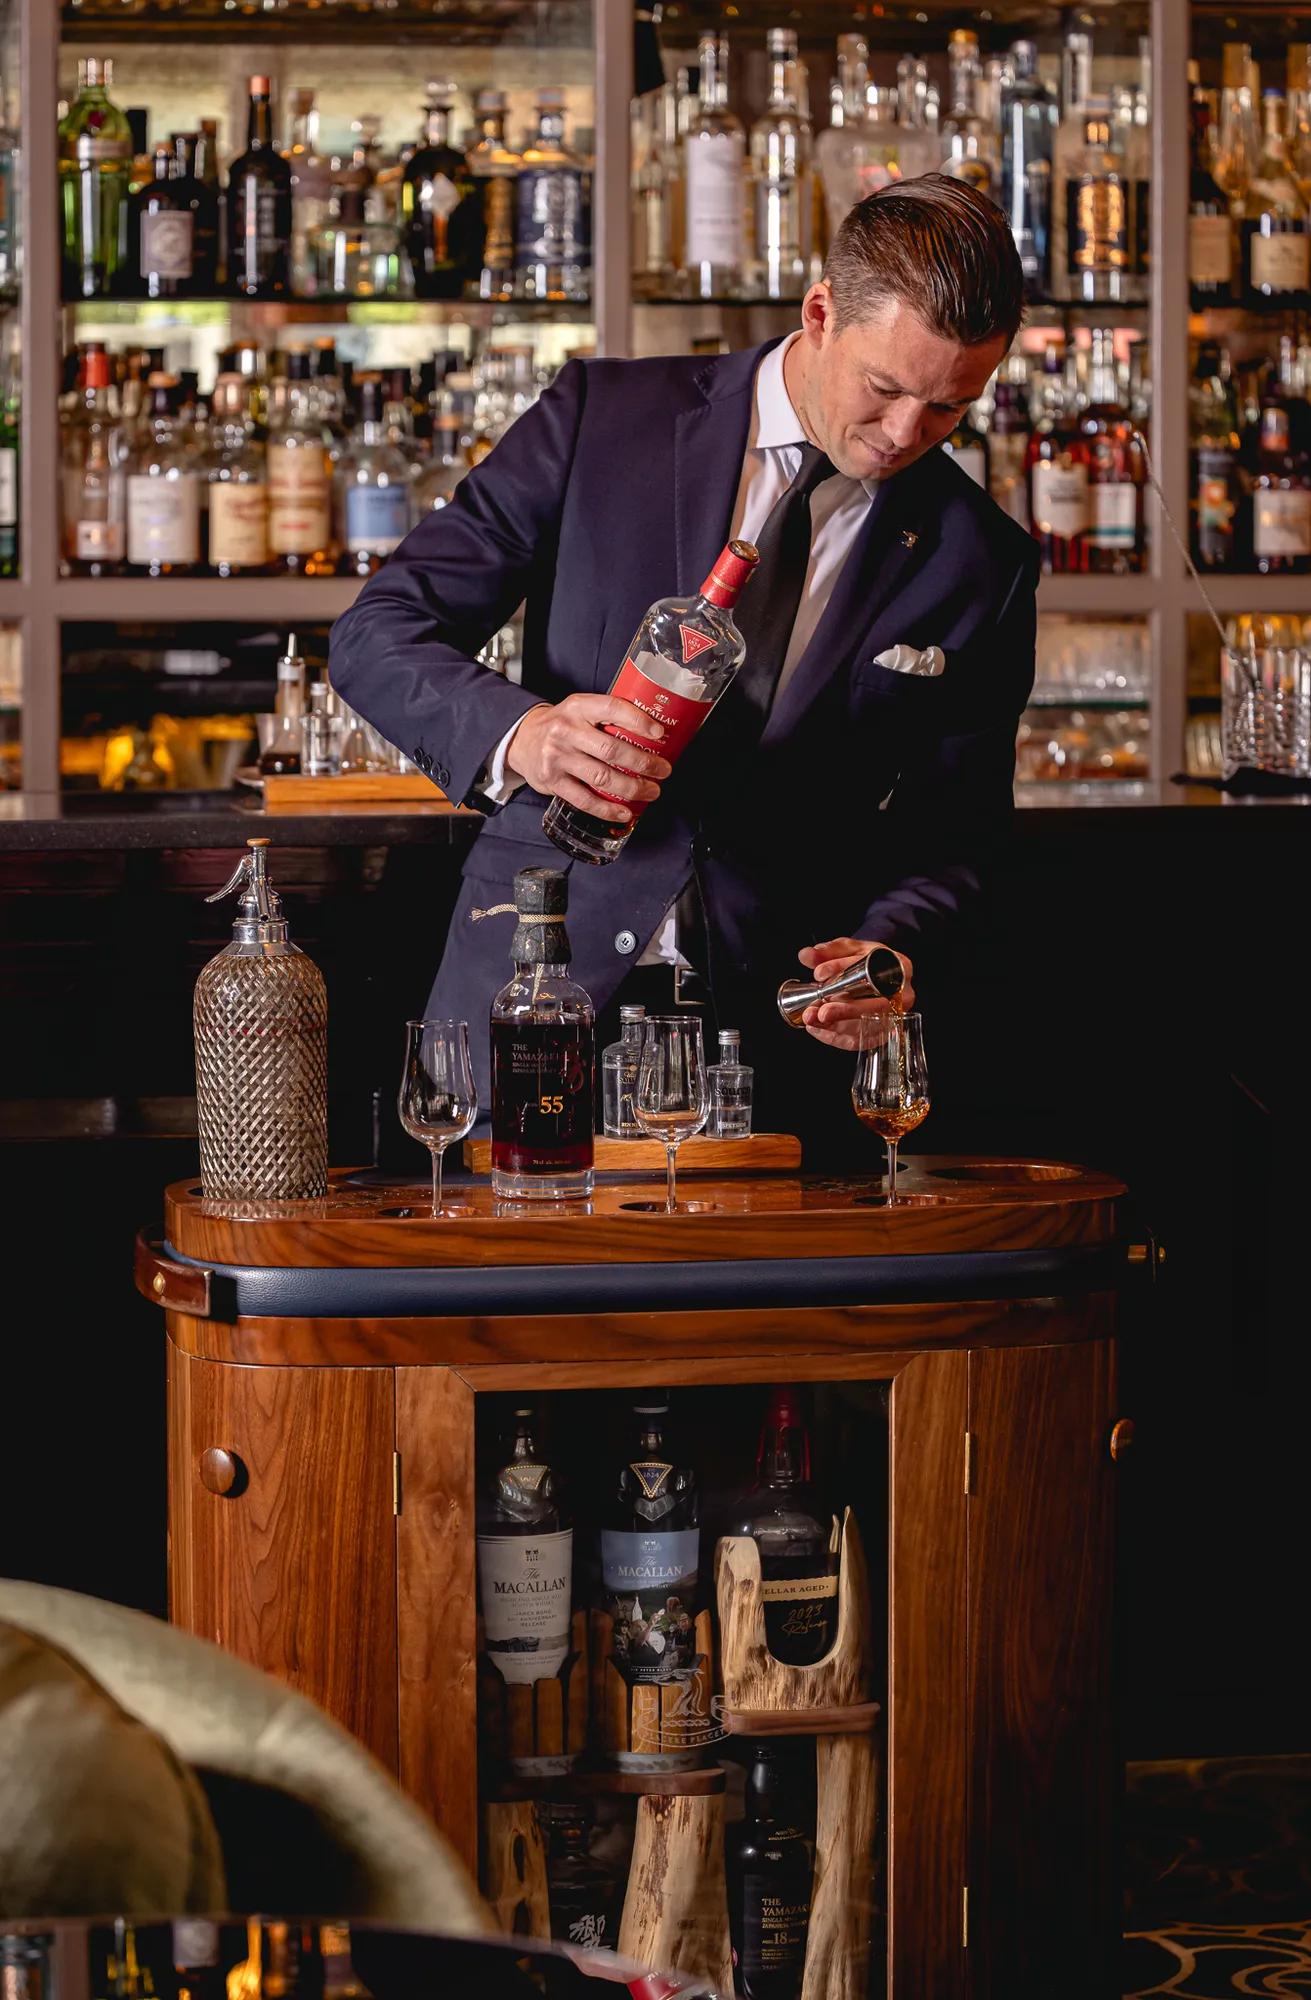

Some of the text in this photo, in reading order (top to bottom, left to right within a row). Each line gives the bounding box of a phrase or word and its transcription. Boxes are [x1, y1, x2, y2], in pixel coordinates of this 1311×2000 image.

[633, 698, 678, 726] MACALLAN
[511, 1043, 528, 1051] THE
[540, 1095, 564, 1114] 55
[523, 1568, 540, 1580] The
[617, 1566, 684, 1578] MACALLAN
[493, 1577, 567, 1594] MACALLAN
[798, 1585, 825, 1593] AGED
[761, 1898, 783, 1906] THE
[761, 1904, 809, 1916] YAMAZAK
[774, 1932, 788, 1945] 18
